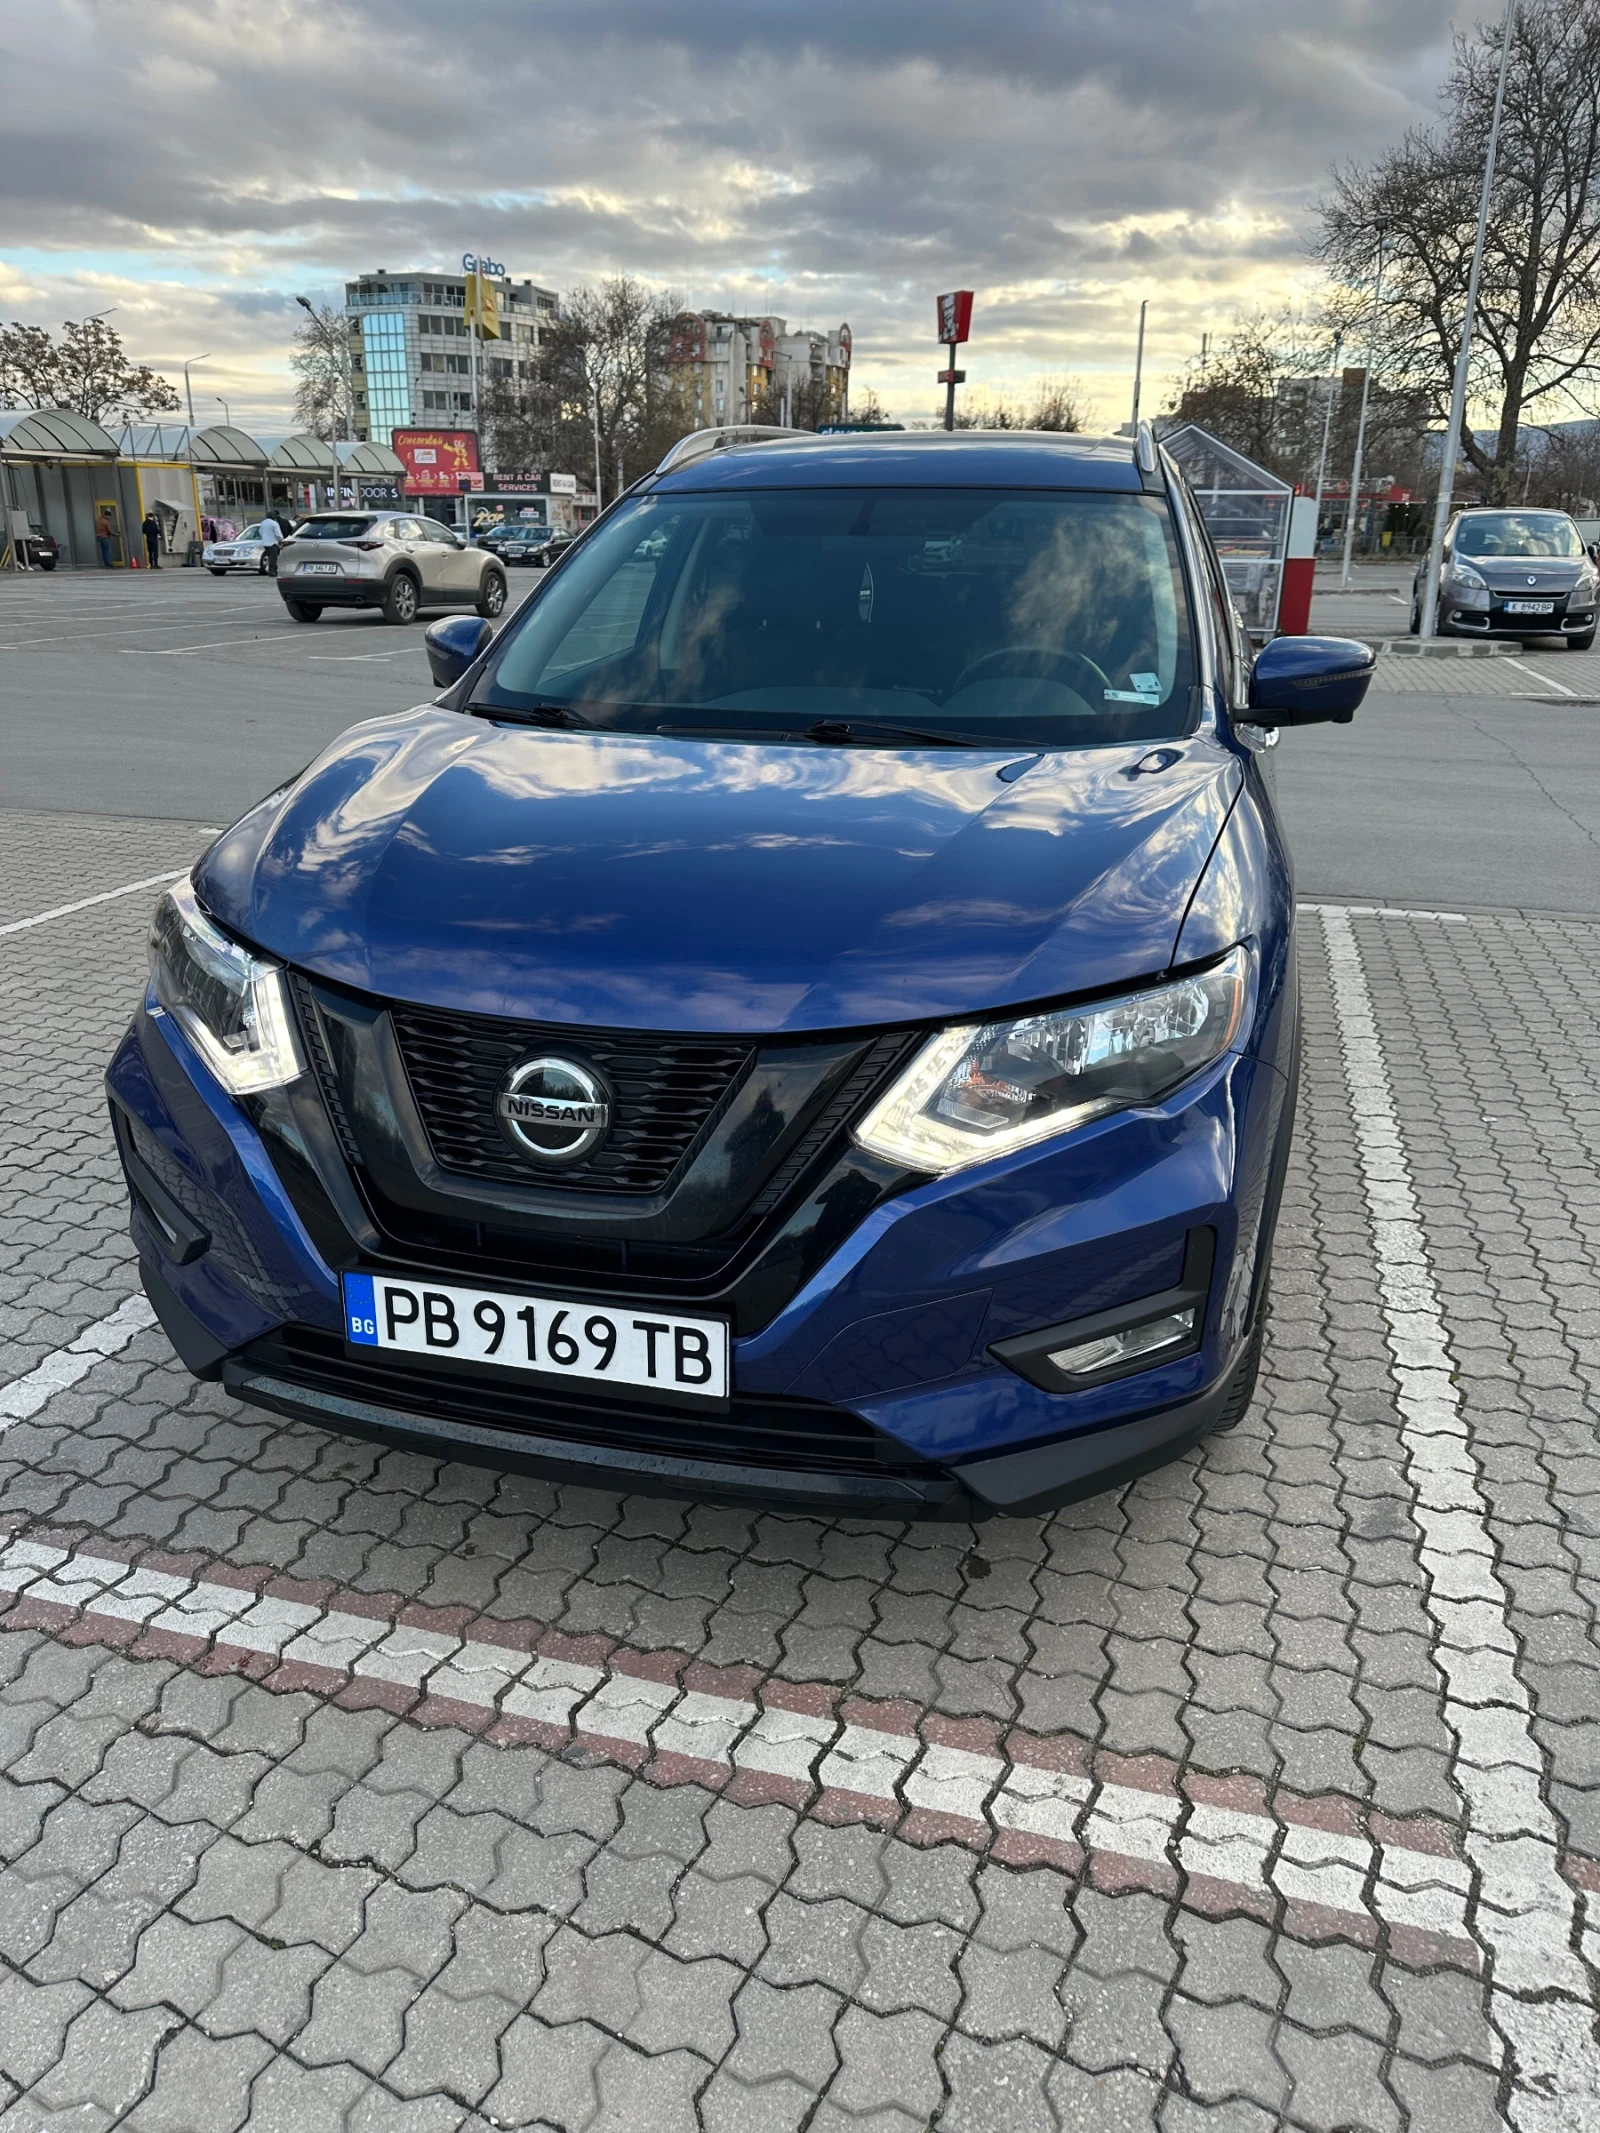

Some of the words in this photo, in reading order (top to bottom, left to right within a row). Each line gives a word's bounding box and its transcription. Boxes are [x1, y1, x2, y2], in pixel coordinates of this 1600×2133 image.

[498, 483, 537, 492] SERVICES
[1511, 603, 1518, 611] K
[1520, 603, 1541, 611] 8942
[1541, 603, 1553, 611] BP
[508, 1099, 595, 1122] NISSAN
[351, 1316, 375, 1335] BG
[383, 1286, 460, 1348] PB
[473, 1299, 617, 1371] 9169
[633, 1320, 712, 1385] TB
